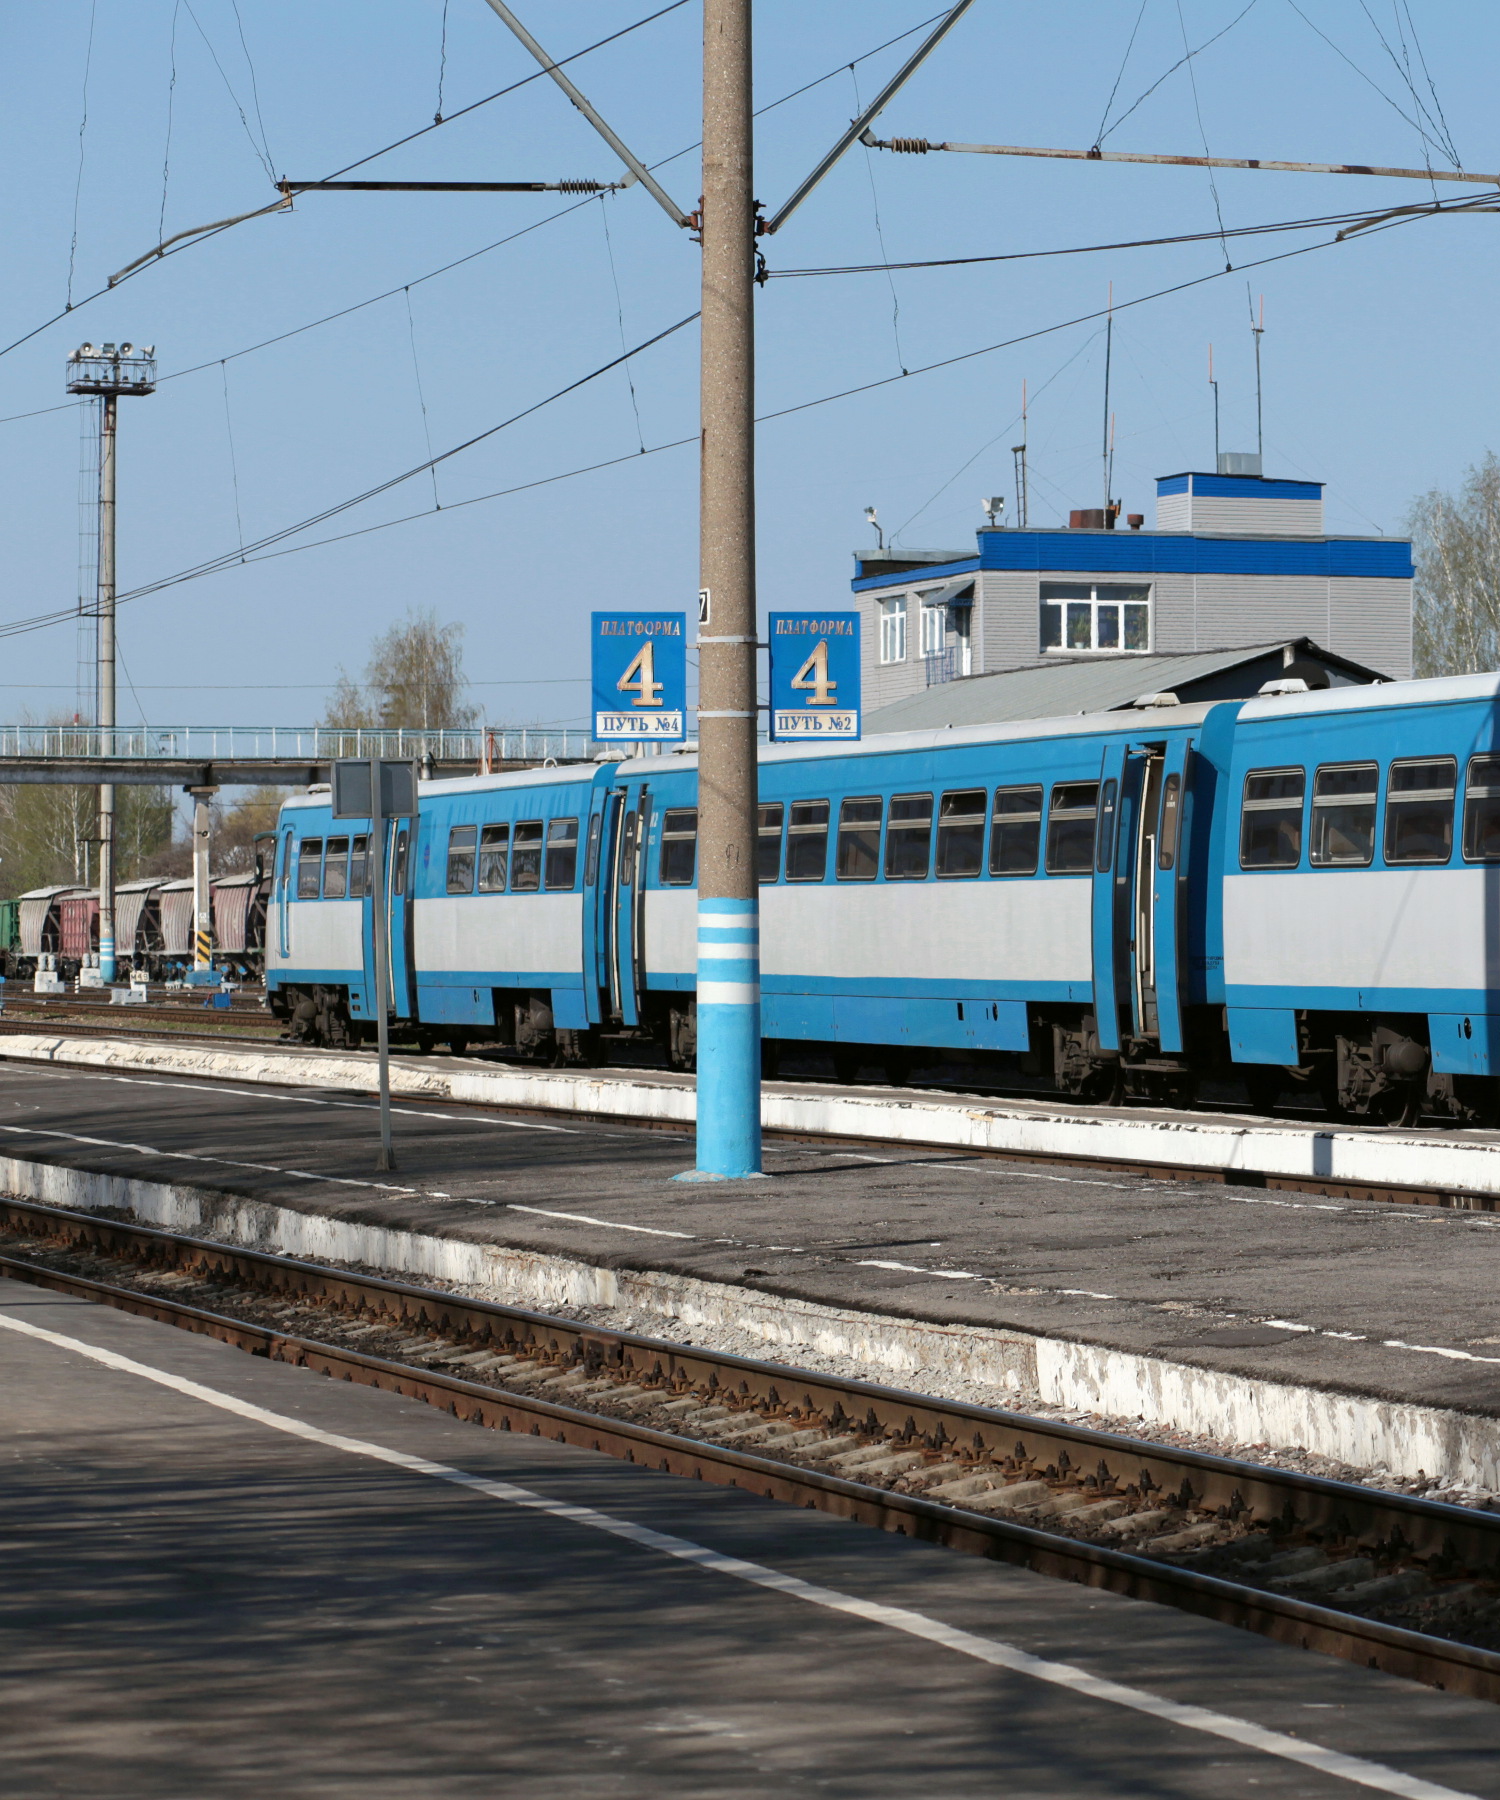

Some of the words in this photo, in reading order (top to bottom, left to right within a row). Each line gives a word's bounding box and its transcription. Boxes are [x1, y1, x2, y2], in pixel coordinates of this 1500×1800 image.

[600, 620, 681, 636] ПЛАТФОРМА
[775, 619, 853, 635] ПЛАТФОРМА
[617, 641, 663, 706] 4
[791, 639, 837, 704] 4
[602, 716, 649, 732] ПУТЬ
[655, 717, 679, 732] №4
[778, 715, 823, 731] ПУТЬ
[828, 716, 852, 731] №2
